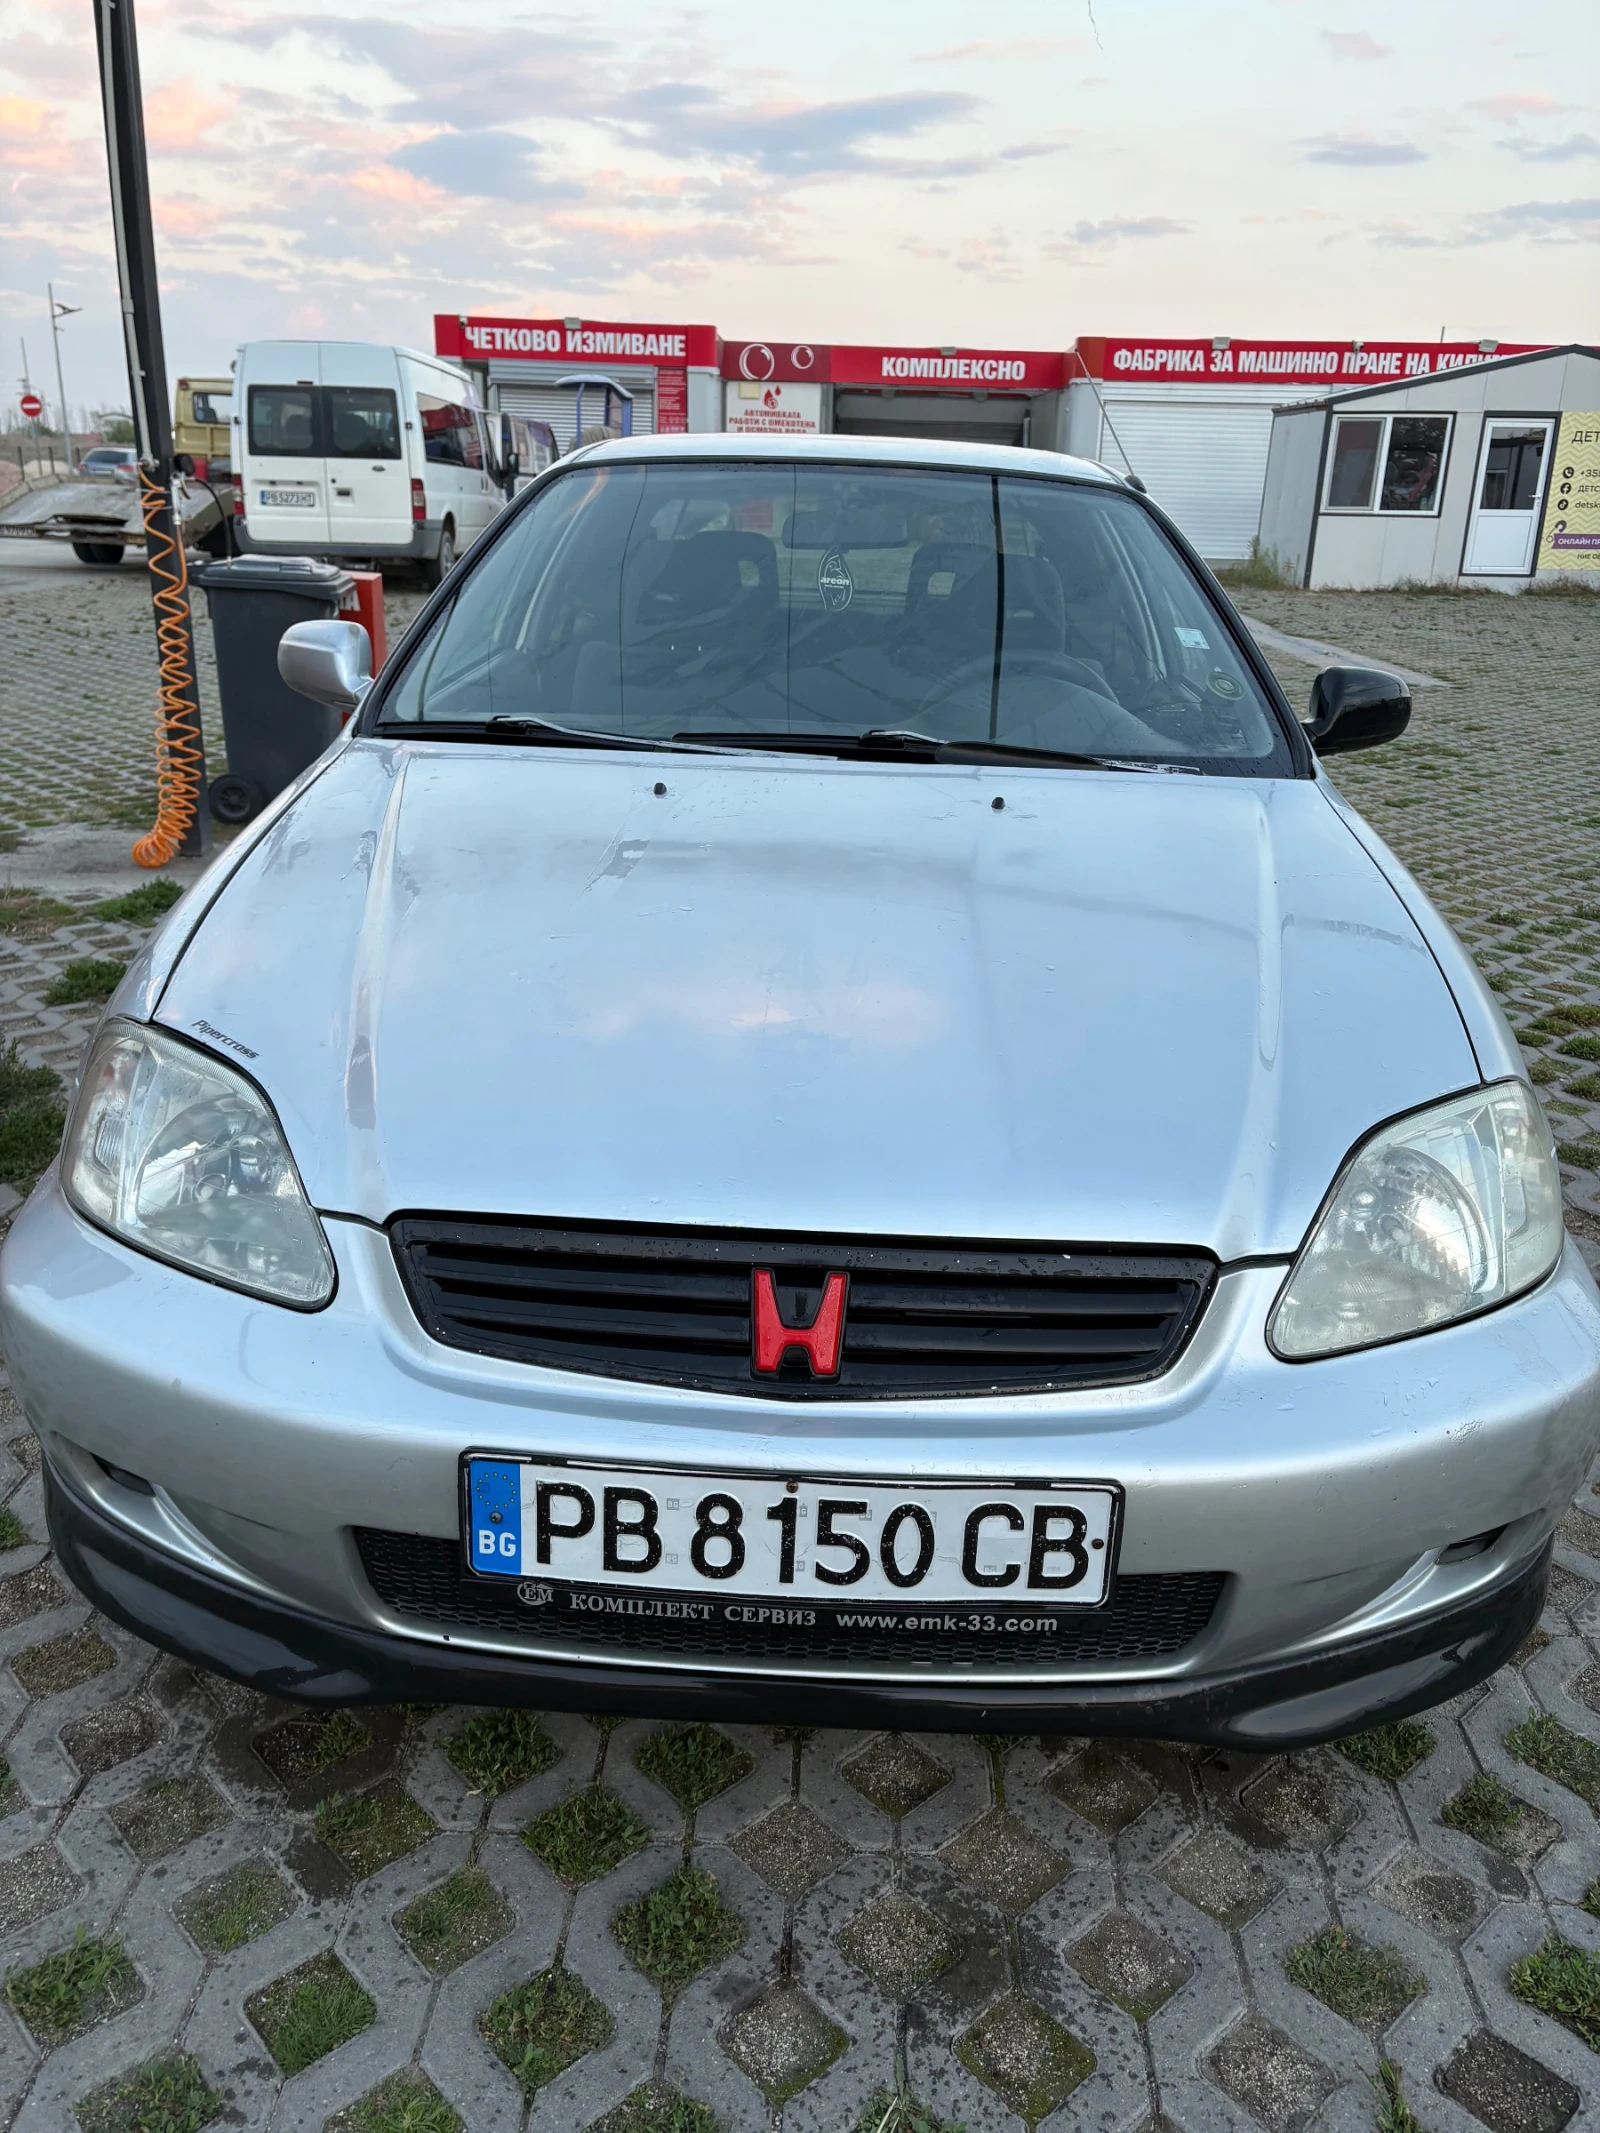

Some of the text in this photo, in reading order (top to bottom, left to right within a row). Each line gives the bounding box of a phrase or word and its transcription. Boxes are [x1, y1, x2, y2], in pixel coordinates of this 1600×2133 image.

[465, 326, 687, 357] ЧЕТКОВО ИЗМИВАНЕ
[881, 356, 1026, 381] КОМПЛЕКСНО
[1113, 348, 1205, 372] ФАБРИКА
[1209, 350, 1234, 373] ЗА
[1237, 350, 1339, 374] МАШИННО
[1341, 352, 1403, 375] ПРАНЕ
[1404, 352, 1430, 375] НА
[1580, 468, 1600, 478] +35
[1574, 501, 1600, 509] detsk
[1557, 537, 1591, 545] ОНЛАЙН
[191, 1019, 260, 1060] Pipercross
[478, 1529, 517, 1557] BG
[535, 1479, 1089, 1589] PB 8150 CB
[569, 1592, 1058, 1632] КОМПЛЕКТ СЕРВИЗ www.emk-33.com
